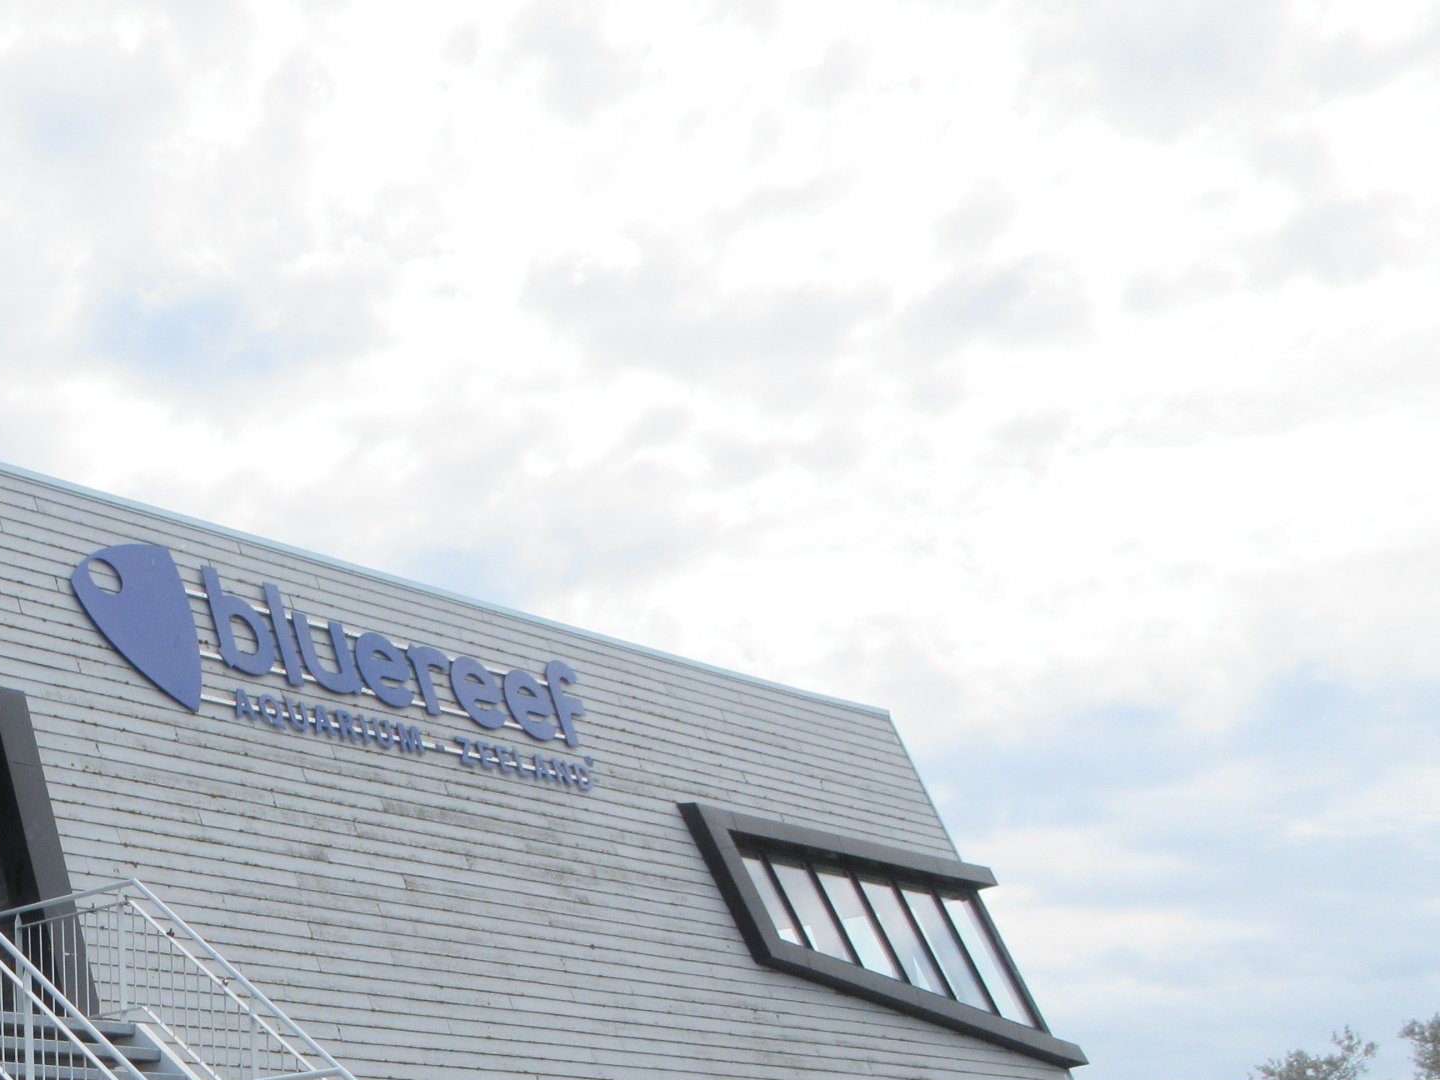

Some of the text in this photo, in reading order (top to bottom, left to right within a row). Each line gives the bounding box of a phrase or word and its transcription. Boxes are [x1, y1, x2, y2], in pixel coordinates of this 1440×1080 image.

[201, 565, 586, 748] bluereef
[236, 688, 426, 756] AQUARIUM
[455, 736, 594, 791] ZEELAND
